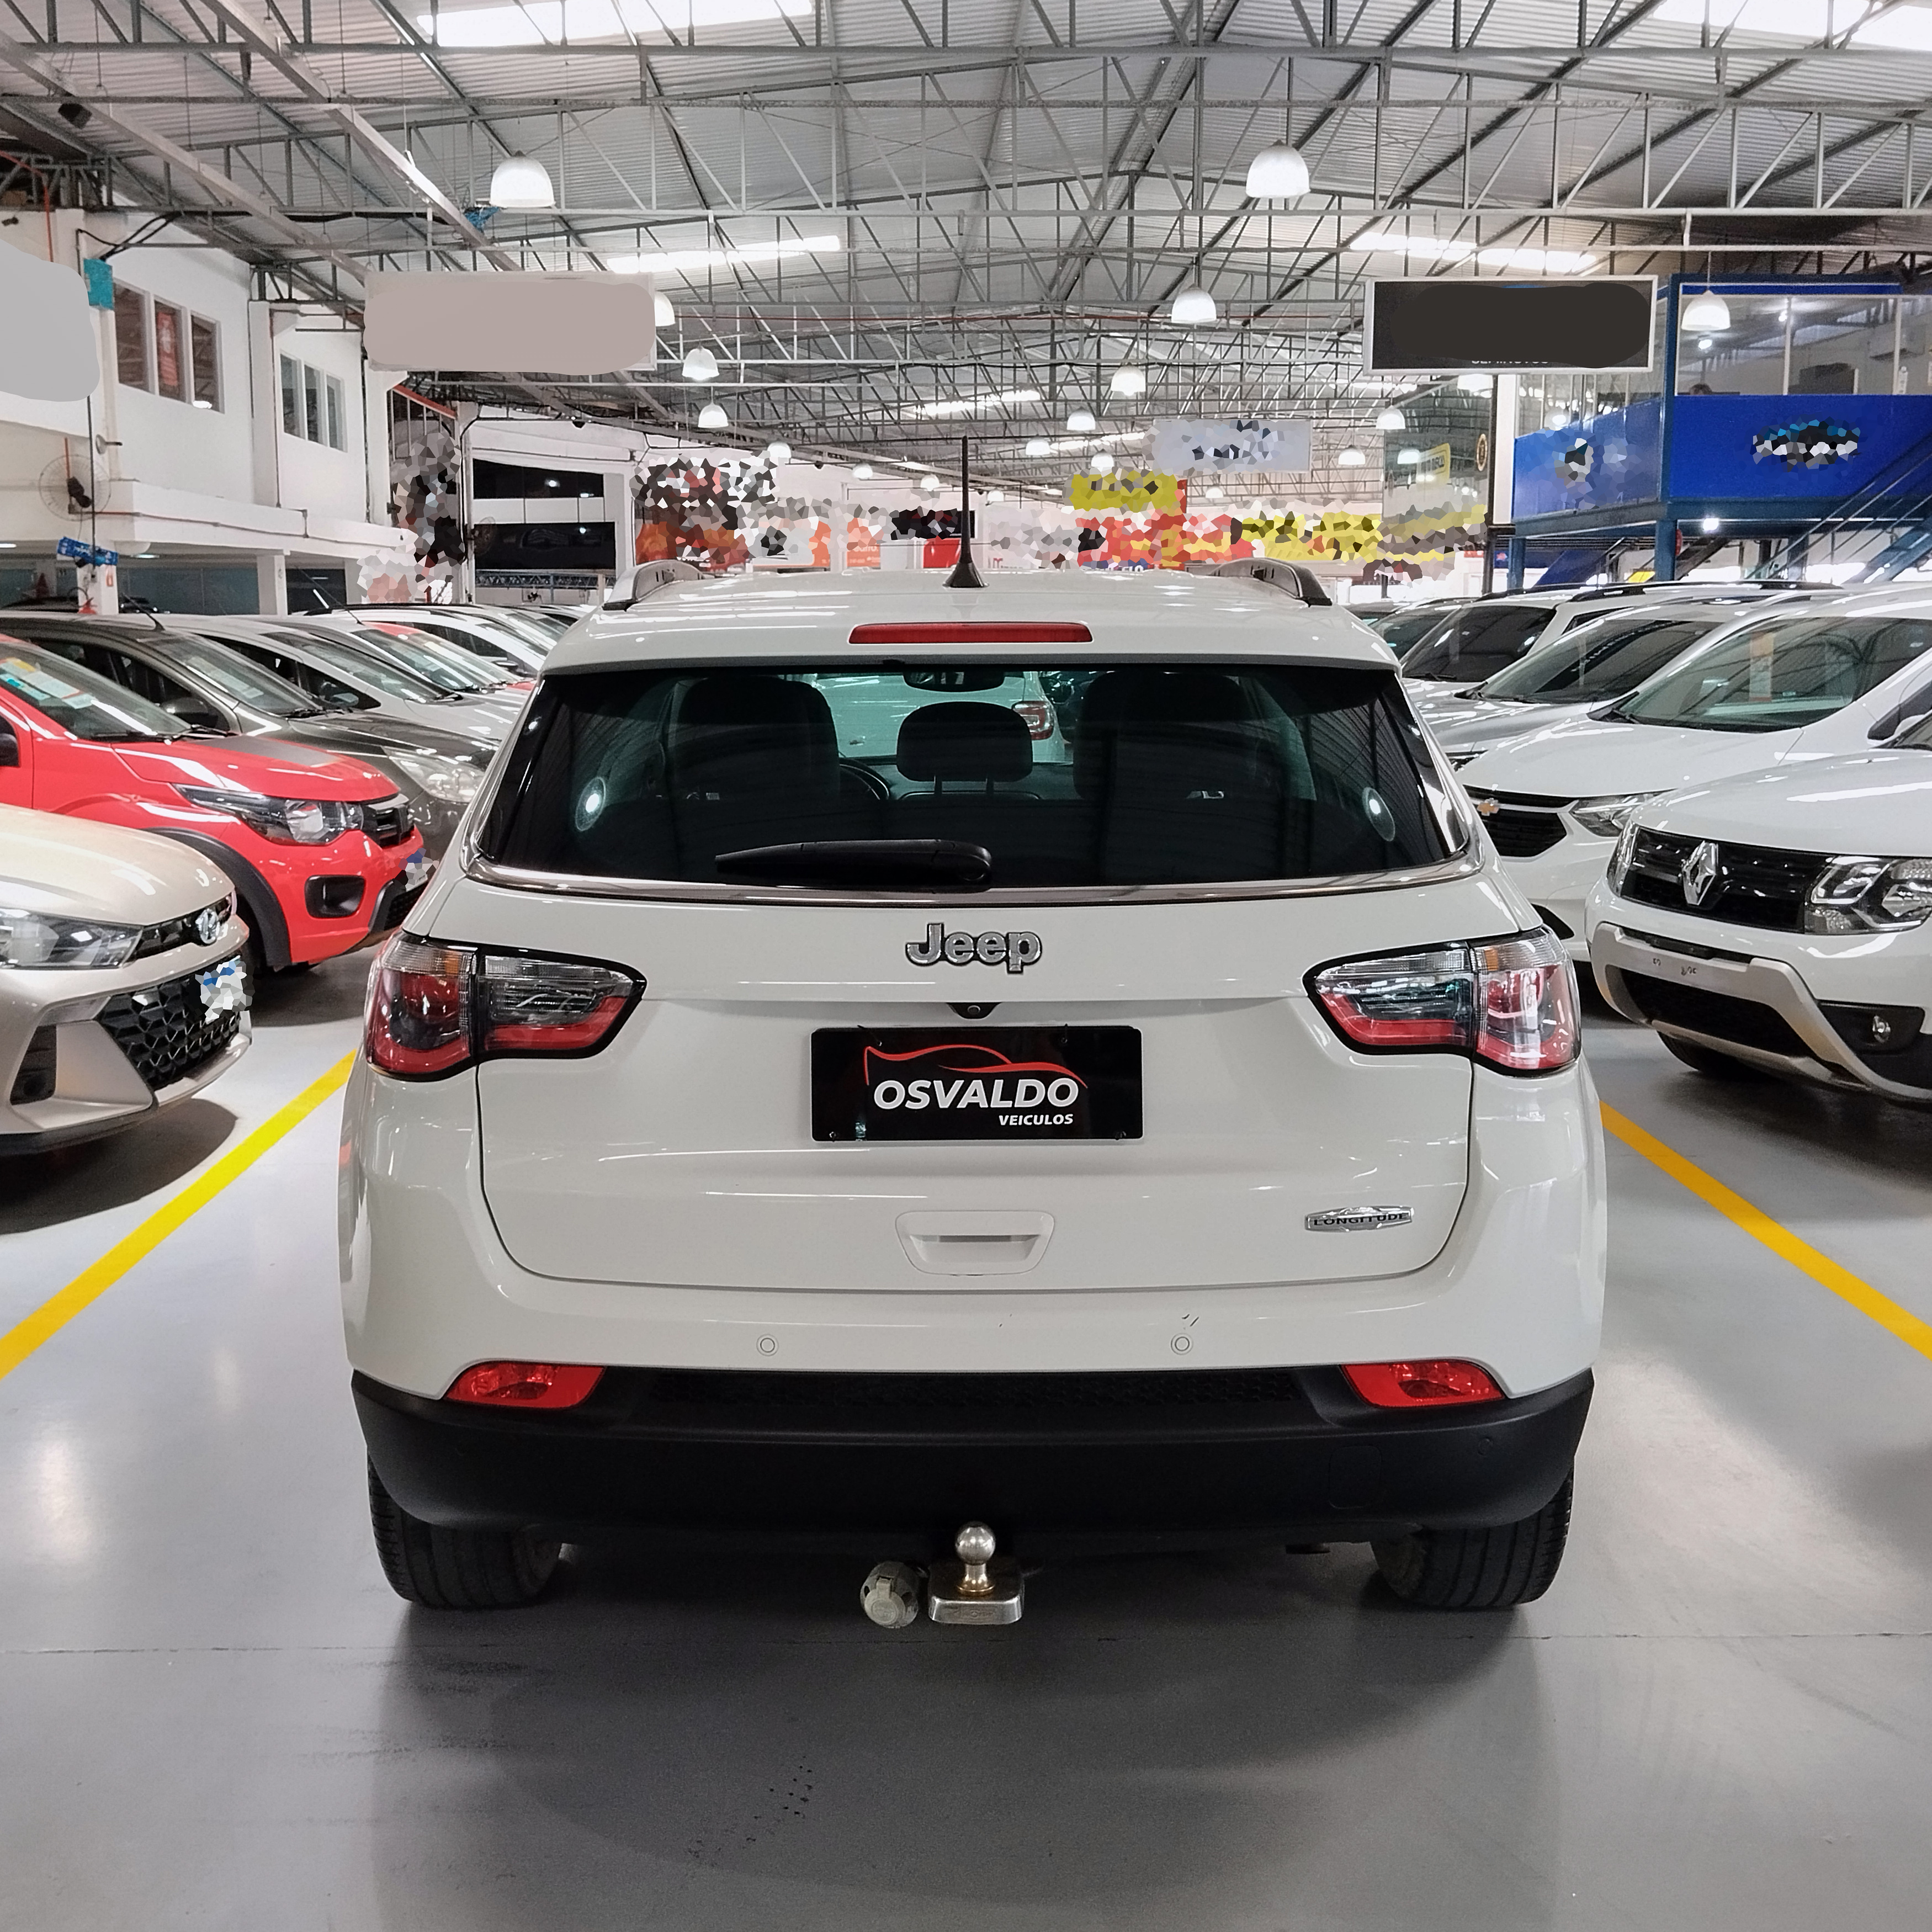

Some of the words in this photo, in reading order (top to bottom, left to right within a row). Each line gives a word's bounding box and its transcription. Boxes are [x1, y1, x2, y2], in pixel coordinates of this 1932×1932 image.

[905, 922, 1042, 974] Jeep
[874, 1078, 1079, 1110] OSVALDO
[999, 1113, 1073, 1126] VEICULOS
[1313, 1213, 1408, 1226] LONGITUDE
